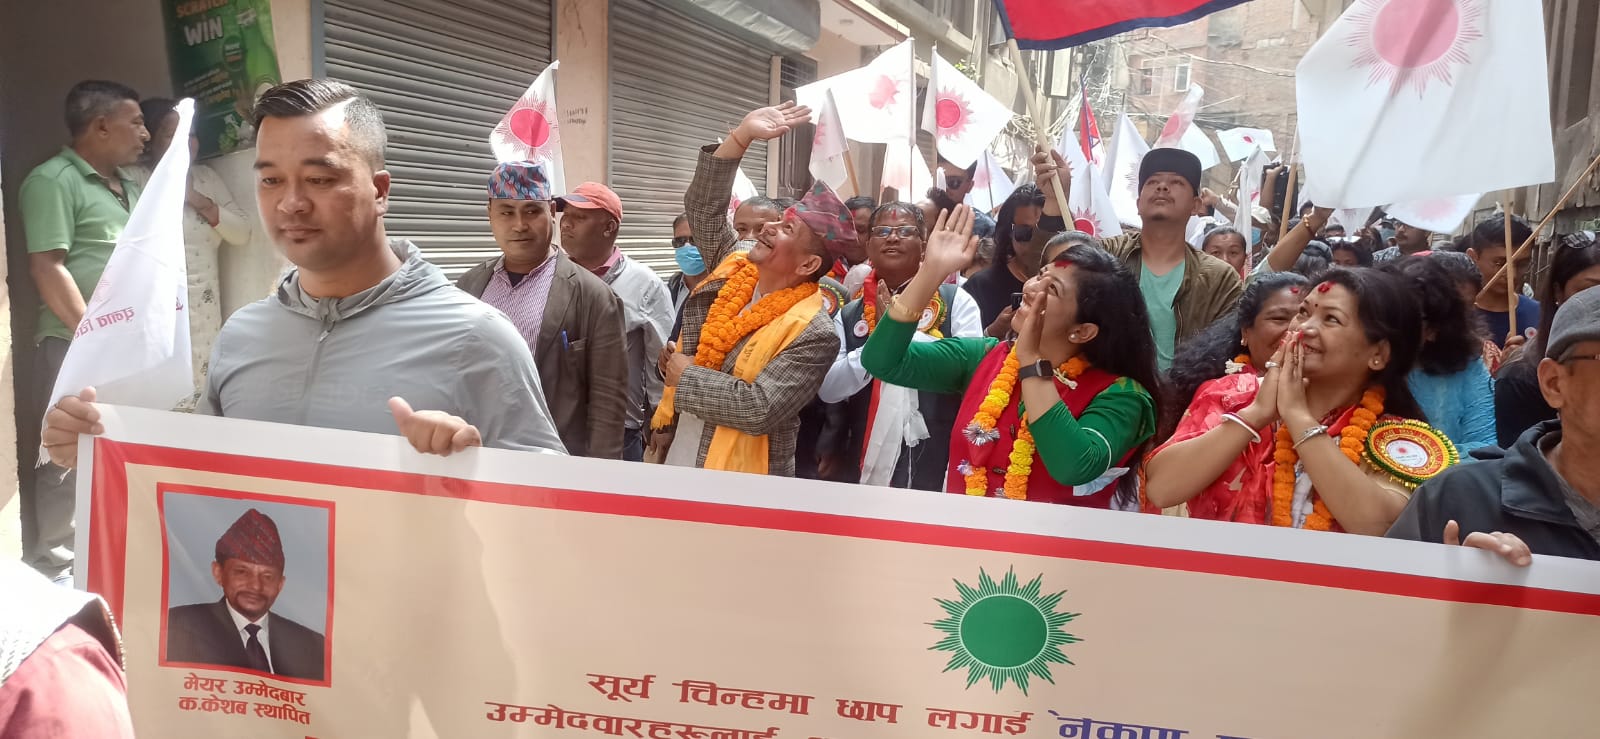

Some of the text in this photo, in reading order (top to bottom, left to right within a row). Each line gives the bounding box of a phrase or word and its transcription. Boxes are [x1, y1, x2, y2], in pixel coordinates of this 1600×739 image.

[184, 15, 224, 46] WIN
[183, 672, 307, 706] मेयर उम्मेदबार
[586, 673, 656, 702] सूर्य
[672, 679, 815, 715] चिन्हमा
[835, 698, 903, 724] छाप
[925, 707, 1034, 736] लगाई
[253, 703, 311, 725] स्थापित
